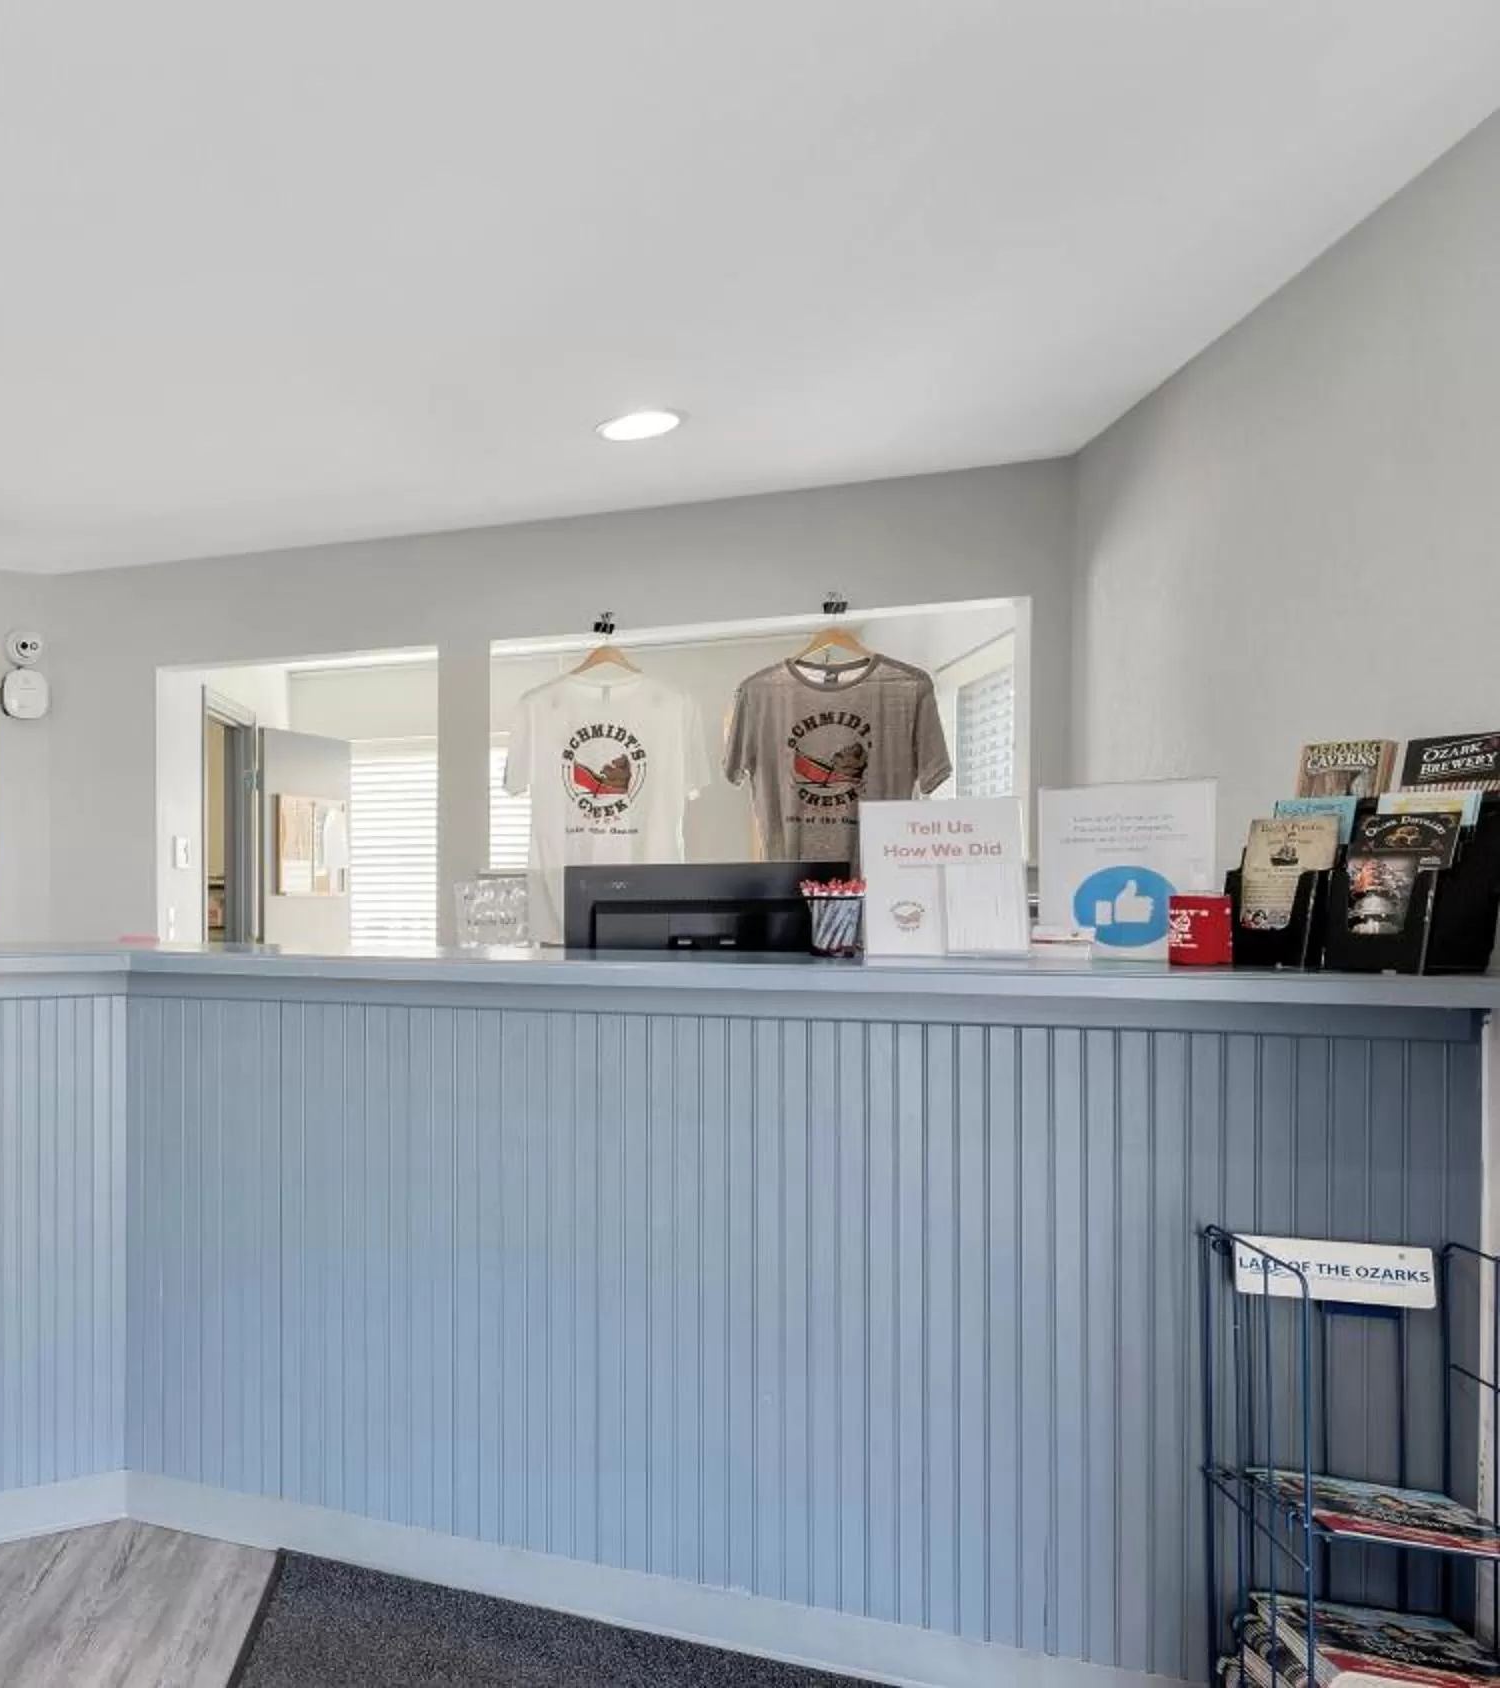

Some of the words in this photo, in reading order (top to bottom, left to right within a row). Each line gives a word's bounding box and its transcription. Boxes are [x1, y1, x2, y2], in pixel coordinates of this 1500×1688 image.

[787, 711, 872, 753] SCHMIDT
[562, 723, 646, 761] SCHMIDT'S
[1307, 752, 1377, 769] CAVERNS
[1423, 743, 1484, 762] OZARK
[1420, 752, 1498, 775] BREWERY
[798, 788, 858, 806] CREEK
[906, 821, 941, 836] Tell
[947, 820, 975, 834] Us
[883, 843, 927, 857] How
[931, 843, 964, 857] We
[968, 841, 1002, 856] Did
[1316, 1263, 1351, 1277] THE
[1355, 1266, 1430, 1283] OZARKS
